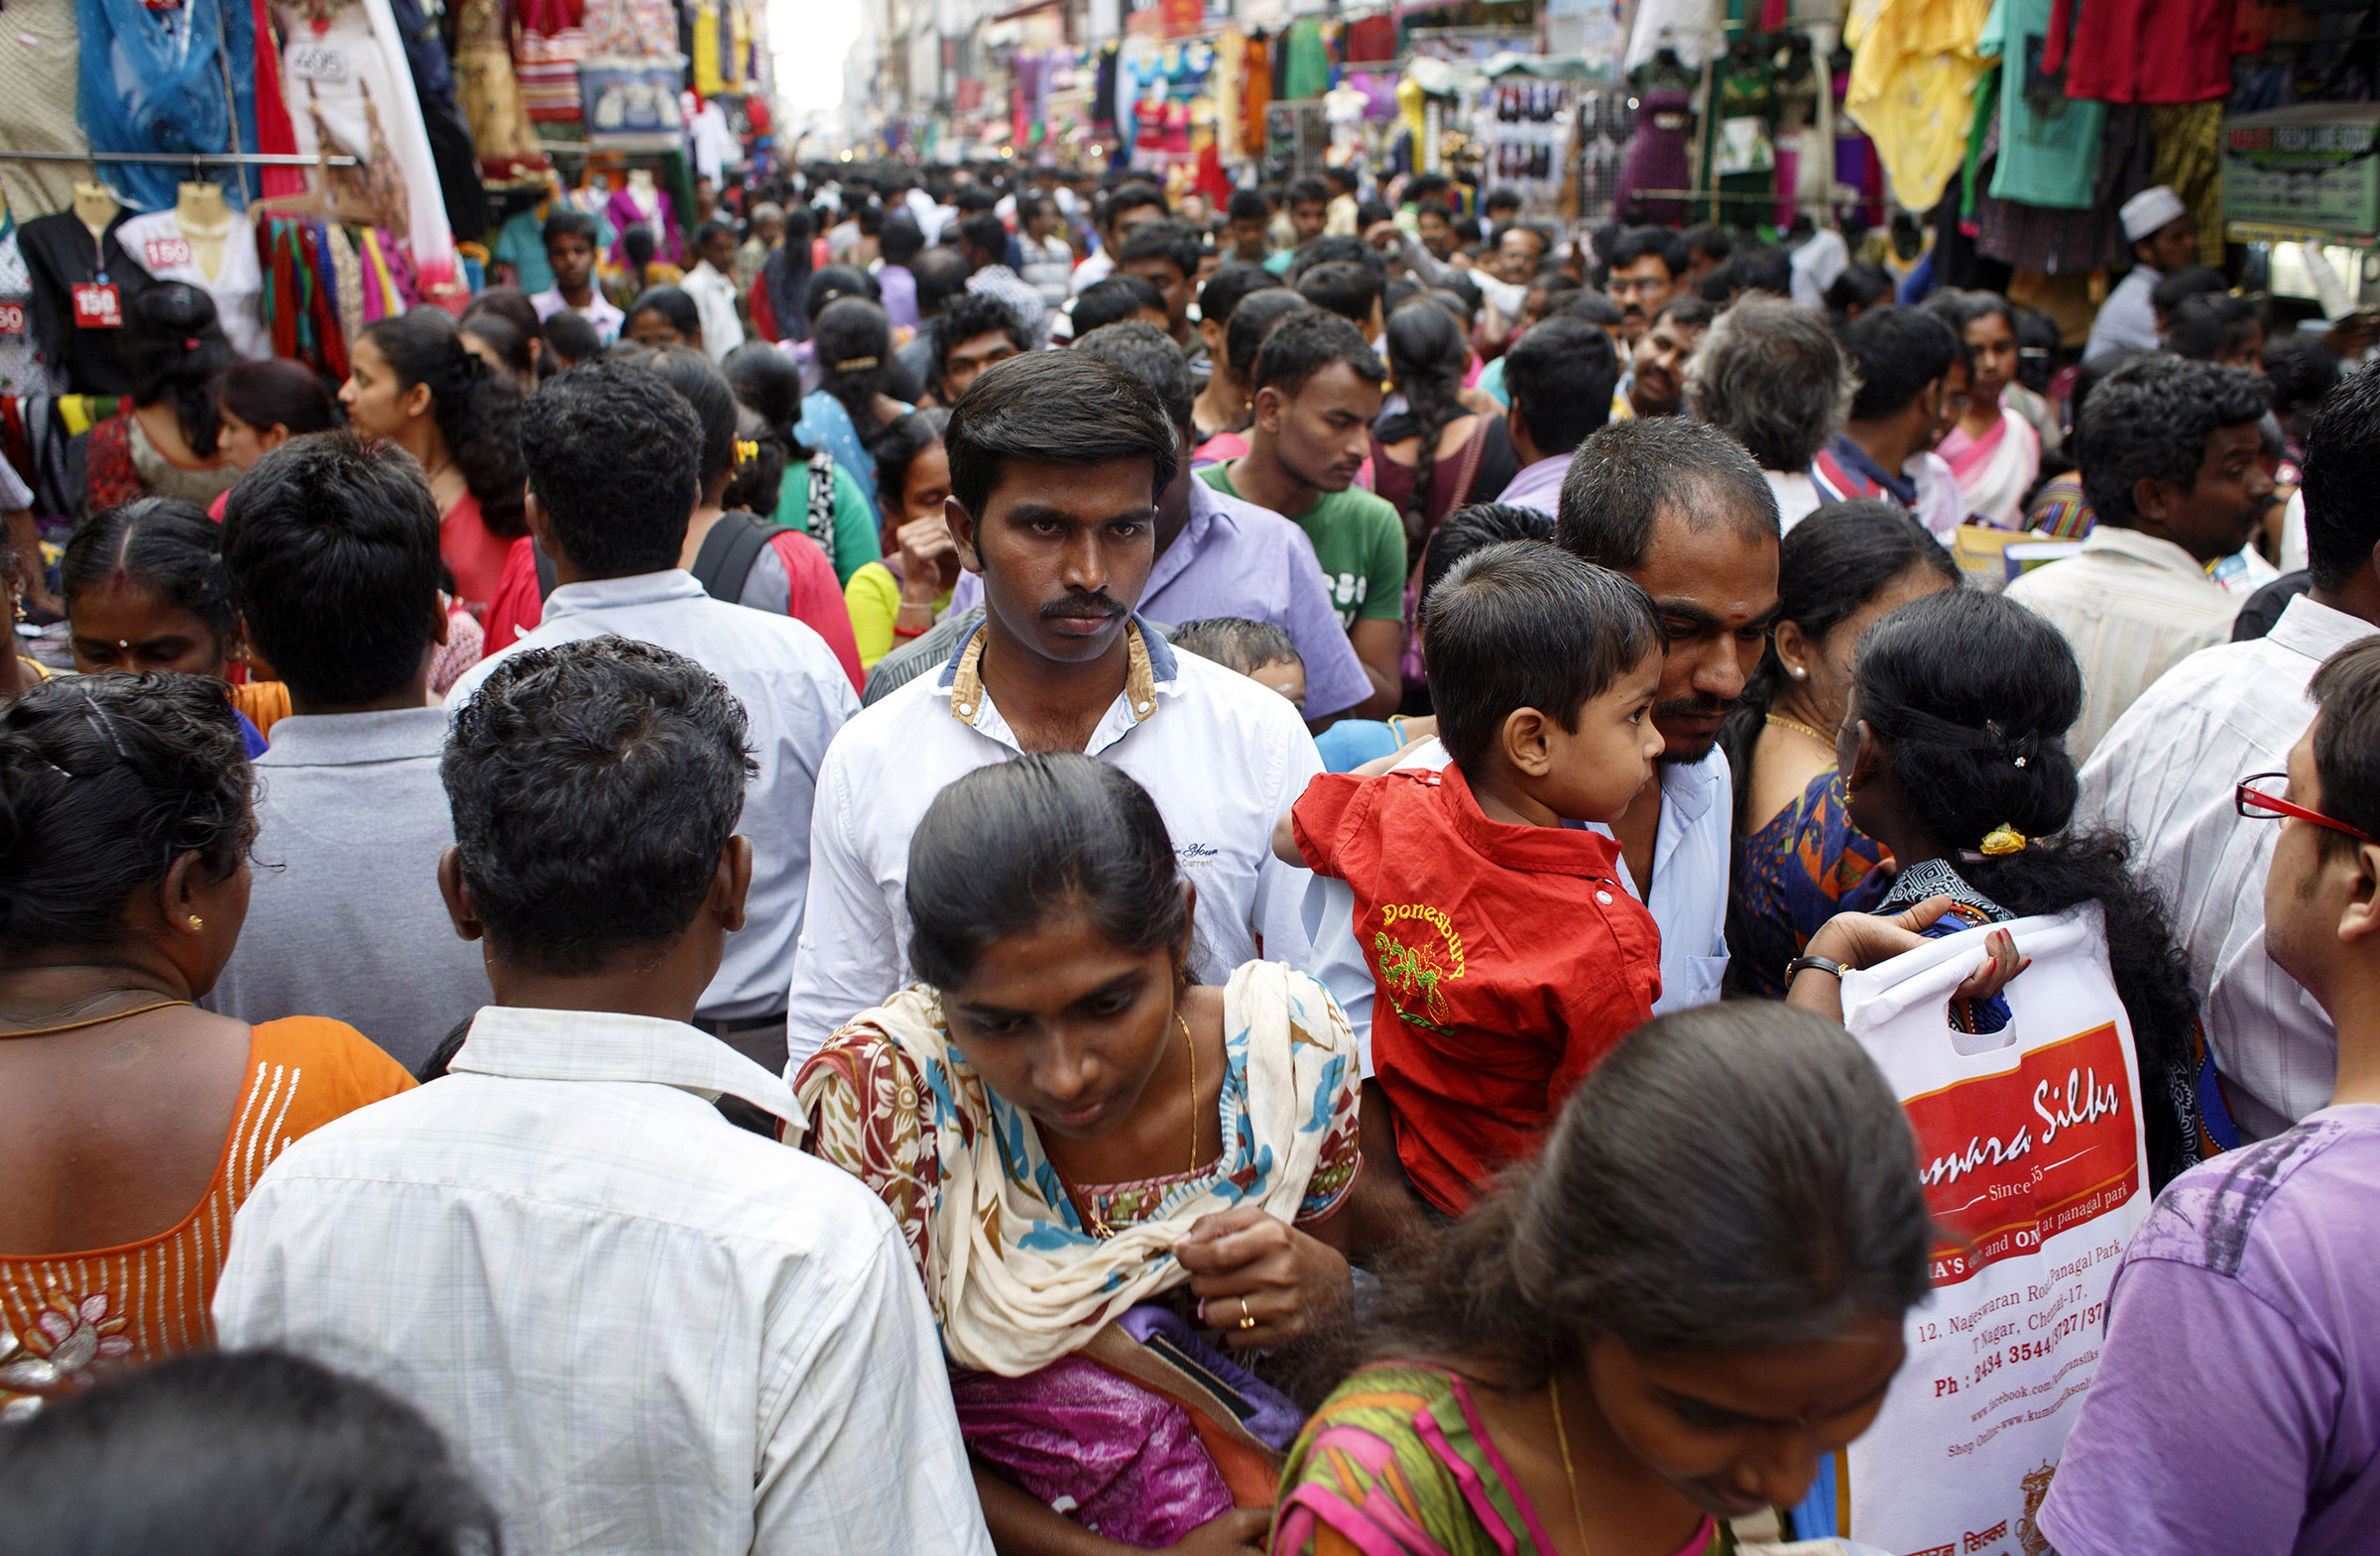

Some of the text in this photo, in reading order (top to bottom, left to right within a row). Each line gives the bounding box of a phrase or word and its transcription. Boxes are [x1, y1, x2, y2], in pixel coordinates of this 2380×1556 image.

[148, 239, 189, 264] 150
[75, 289, 116, 315] 150
[0, 306, 23, 328] 50
[2033, 1067, 2119, 1144] Silks
[1989, 1181, 2032, 1201] Since
[1985, 1235, 2009, 1257] and
[2043, 1216, 2054, 1232] at
[2058, 1193, 2100, 1230] panagal
[2105, 1181, 2128, 1210] park
[1949, 1292, 2020, 1335] Nageswaran
[2050, 1251, 2092, 1285] Panagal
[1935, 1376, 1959, 1398] Ph
[1974, 1351, 2002, 1383] 2434
[2009, 1300, 2106, 1364] 3544/3727/37
[1948, 1441, 1974, 1458] Shop
